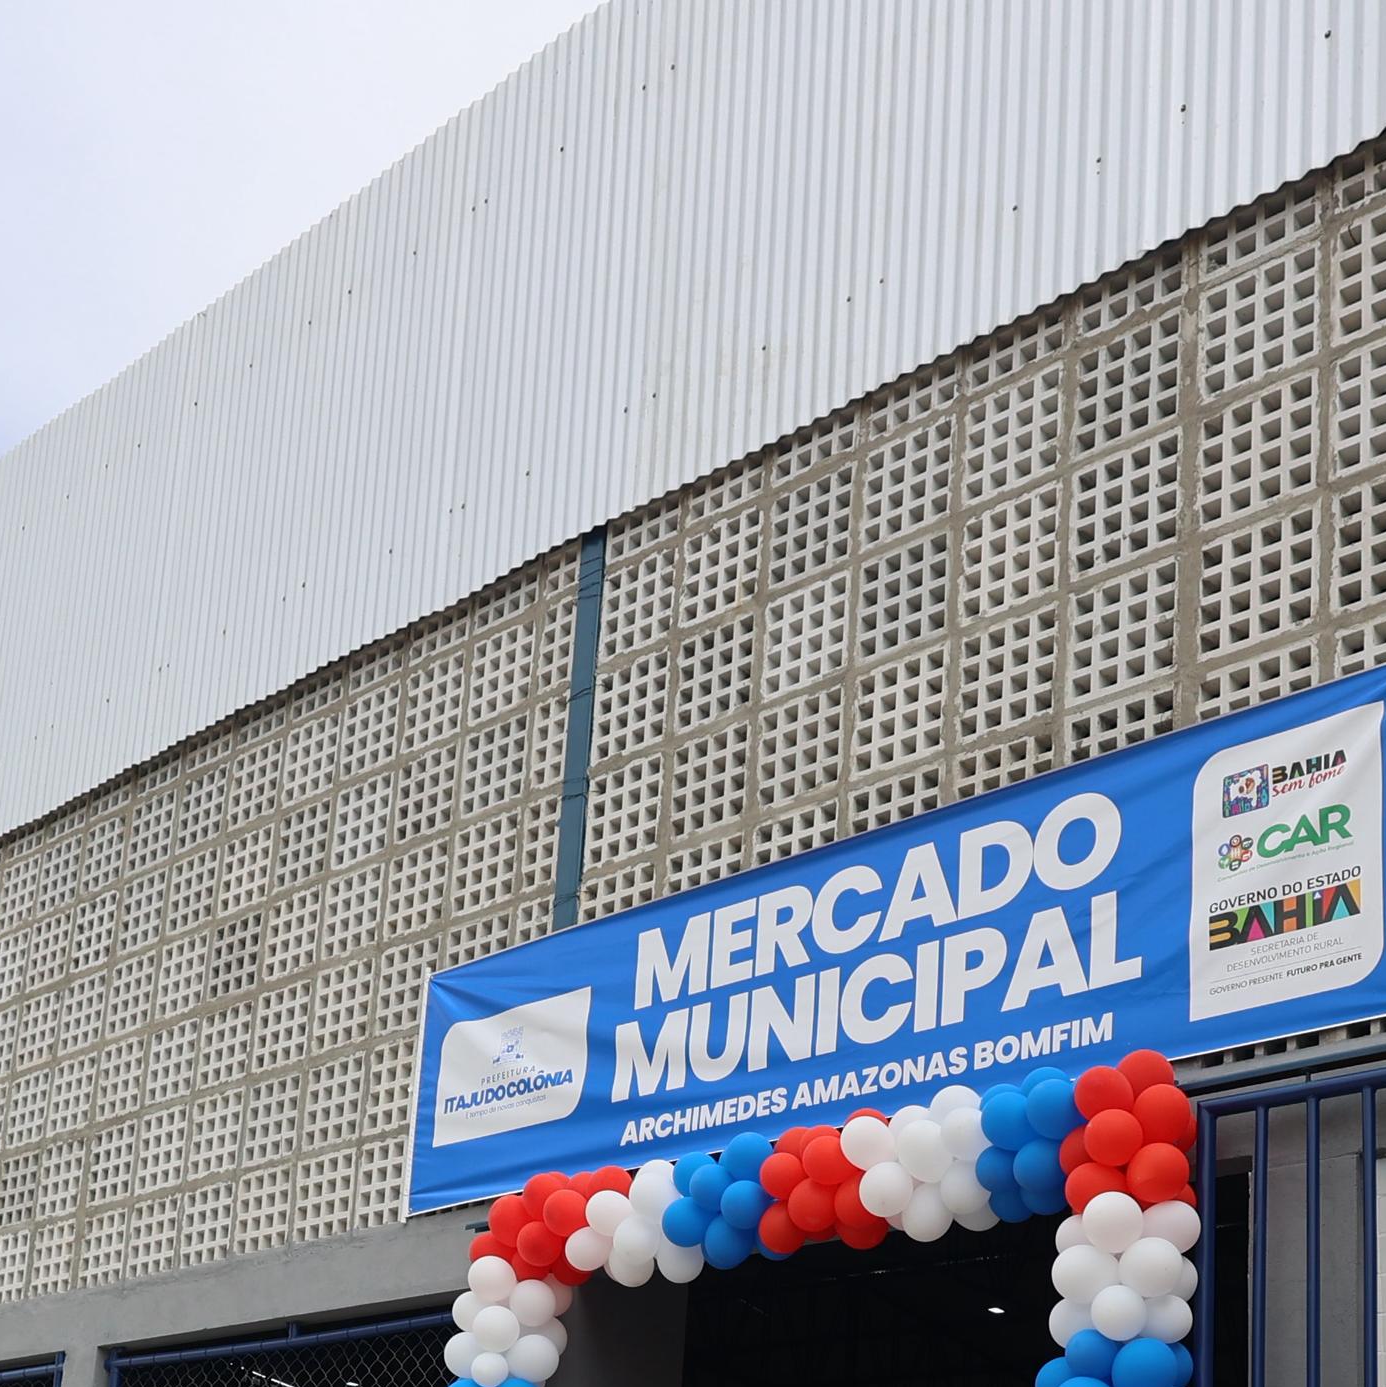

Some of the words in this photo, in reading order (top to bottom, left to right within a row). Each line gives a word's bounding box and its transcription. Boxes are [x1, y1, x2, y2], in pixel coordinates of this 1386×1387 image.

[1272, 749, 1347, 785] BAHIA
[1272, 780, 1305, 798] sem
[1308, 764, 1345, 789] fome
[1256, 803, 1353, 859] CAR
[633, 792, 1122, 1011] MERCADO
[1209, 887, 1278, 914] GOVERNO
[1282, 881, 1302, 896] DO
[1307, 865, 1361, 890] ESTADO
[1209, 880, 1361, 951] BAHIA
[1226, 945, 1311, 973] DESENVOLVIMENTO
[1314, 937, 1344, 951] RURAL
[1250, 935, 1305, 956] SECRETARIA
[1307, 932, 1318, 942] DE
[611, 890, 1143, 1104] MUNICIPAL
[1209, 980, 1247, 996] GOVERNO
[1248, 972, 1283, 986] PRESENTE
[1286, 965, 1318, 978] FUTURO
[1319, 960, 1335, 970] PRA
[1336, 952, 1362, 966] GENTE
[481, 1065, 536, 1086] PREFEITURA
[620, 1088, 787, 1146] ARCHIMEDES
[792, 1047, 967, 1109] AMAZONAS
[973, 1012, 1113, 1071] BOMFIM
